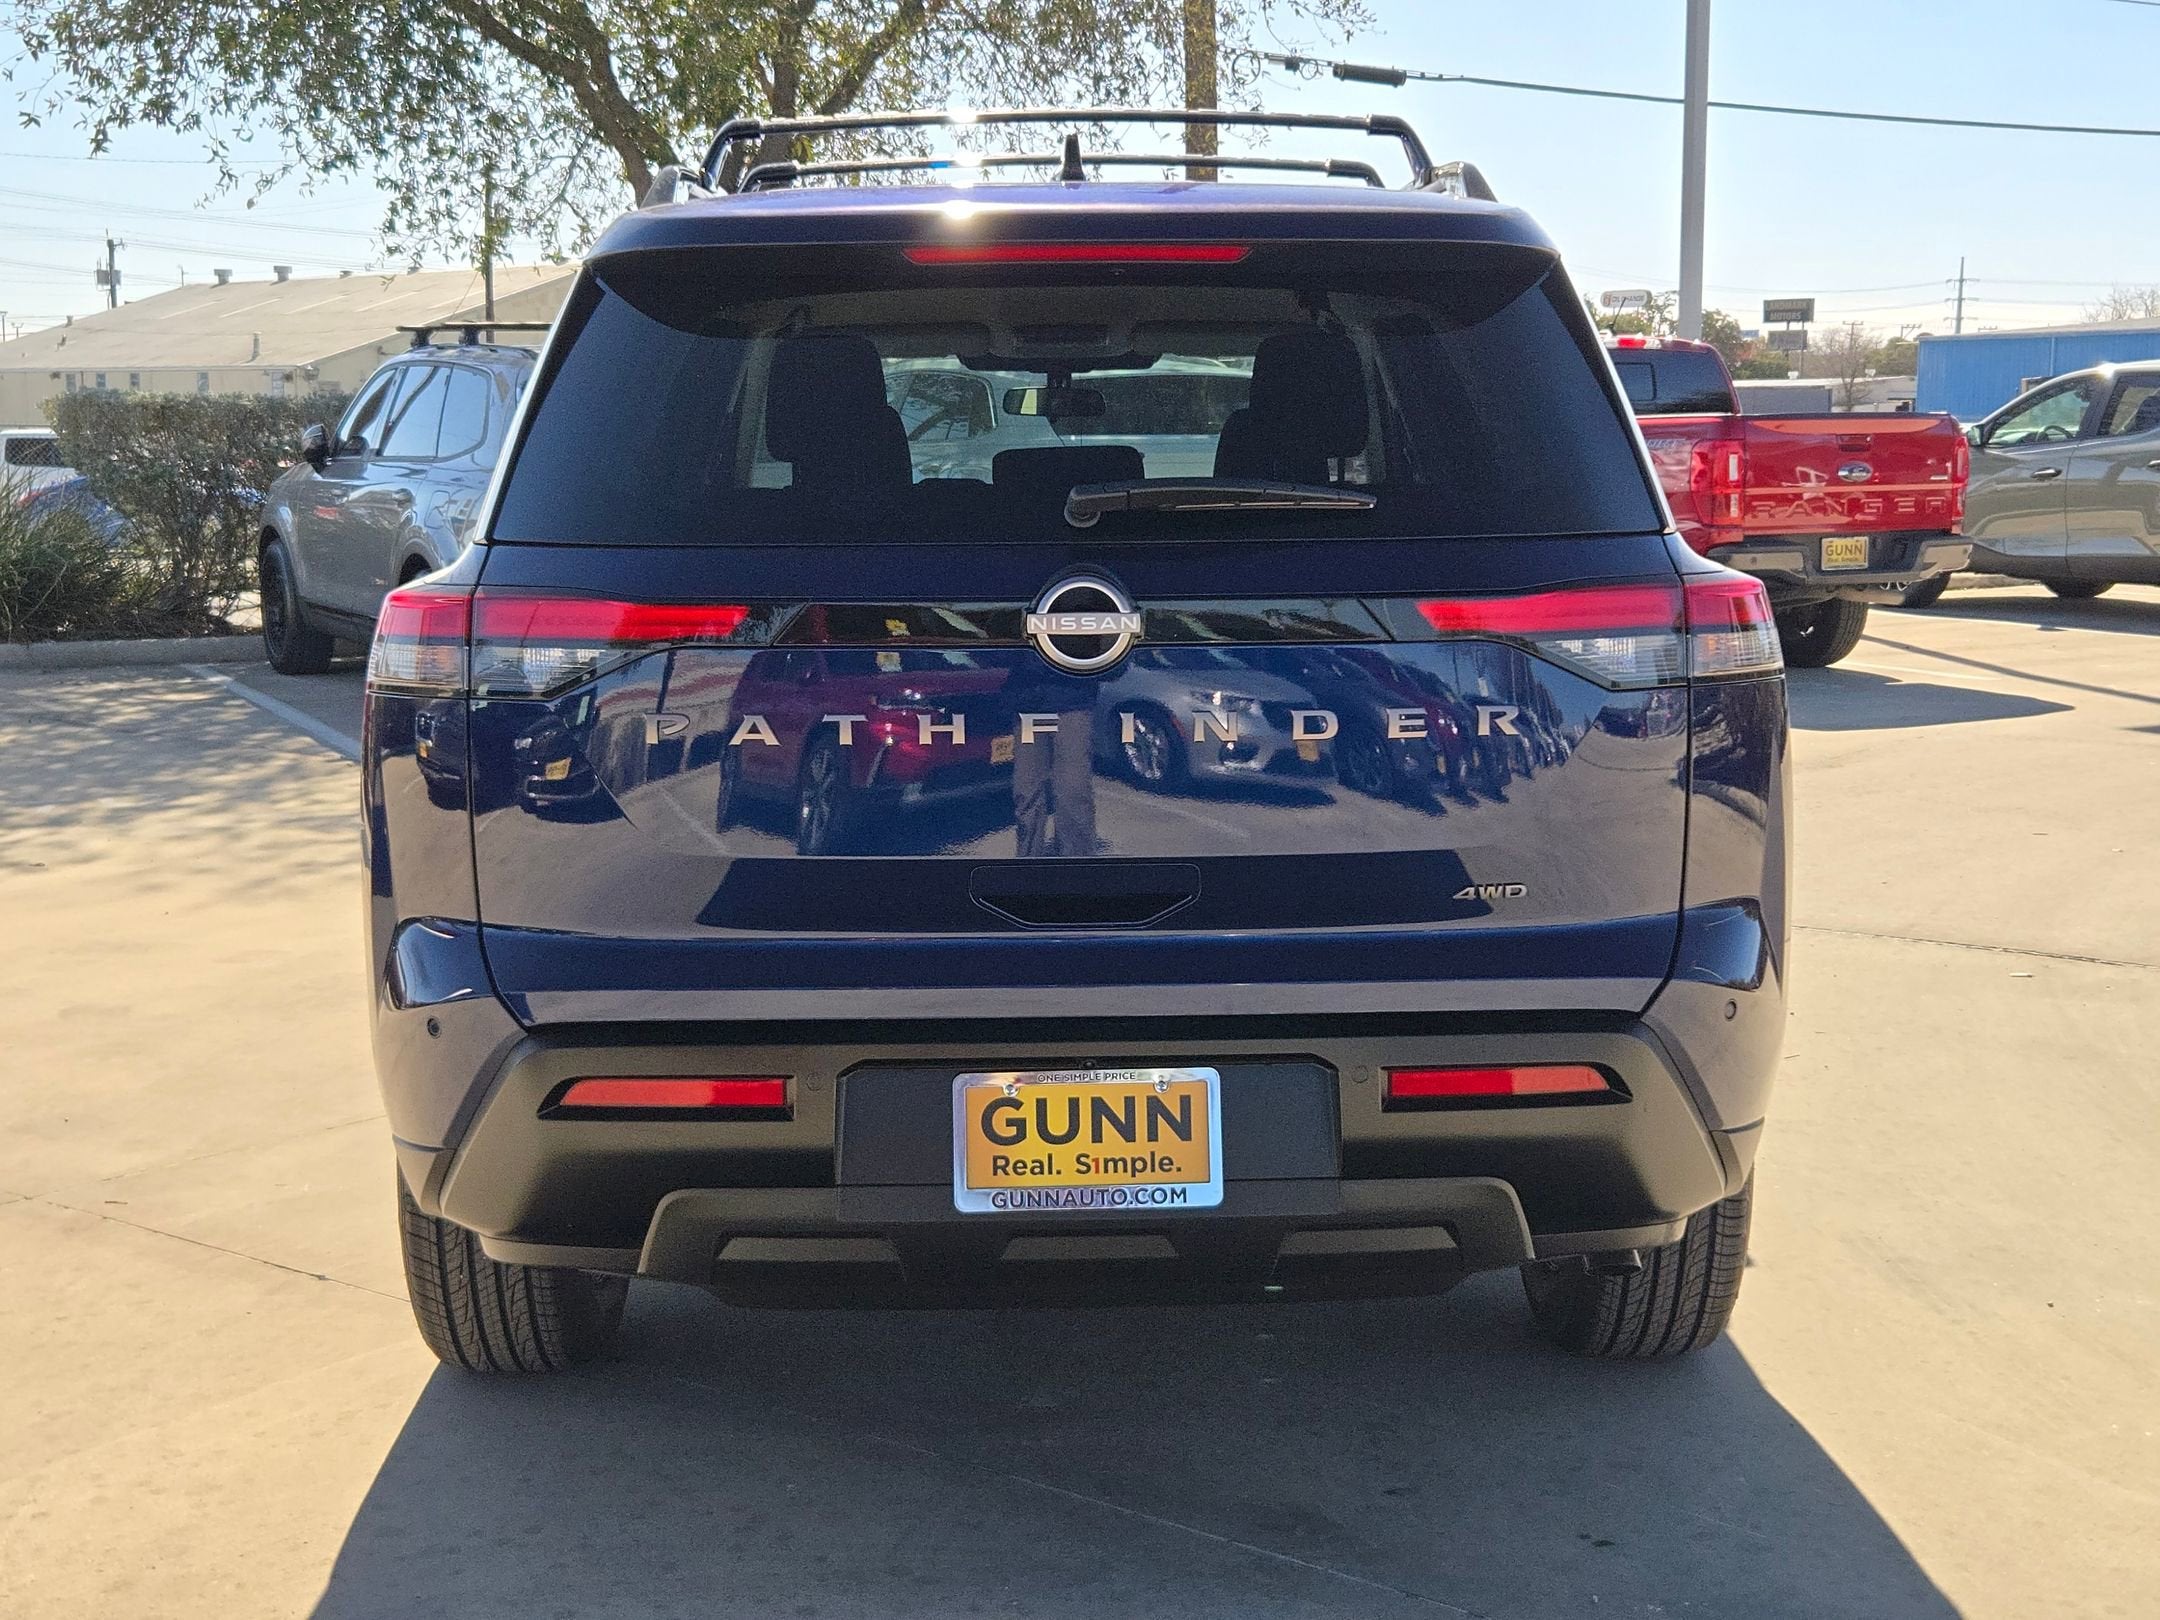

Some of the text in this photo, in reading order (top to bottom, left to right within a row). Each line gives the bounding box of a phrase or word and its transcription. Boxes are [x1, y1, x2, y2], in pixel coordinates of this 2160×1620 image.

[1769, 311, 1802, 321] MOTORS
[1752, 497, 1946, 519] RANGER
[1825, 543, 1863, 557] GUNN
[1031, 616, 1137, 631] NISSAN
[643, 704, 1521, 746] PATHFINDER
[1452, 882, 1528, 901] 4WD
[1038, 1071, 1136, 1083] ONE SIMPLE PRICE
[981, 1094, 1193, 1147] GUNN
[992, 1153, 1062, 1177] Real.
[991, 1186, 1188, 1209] GUNNAUTO.COM
